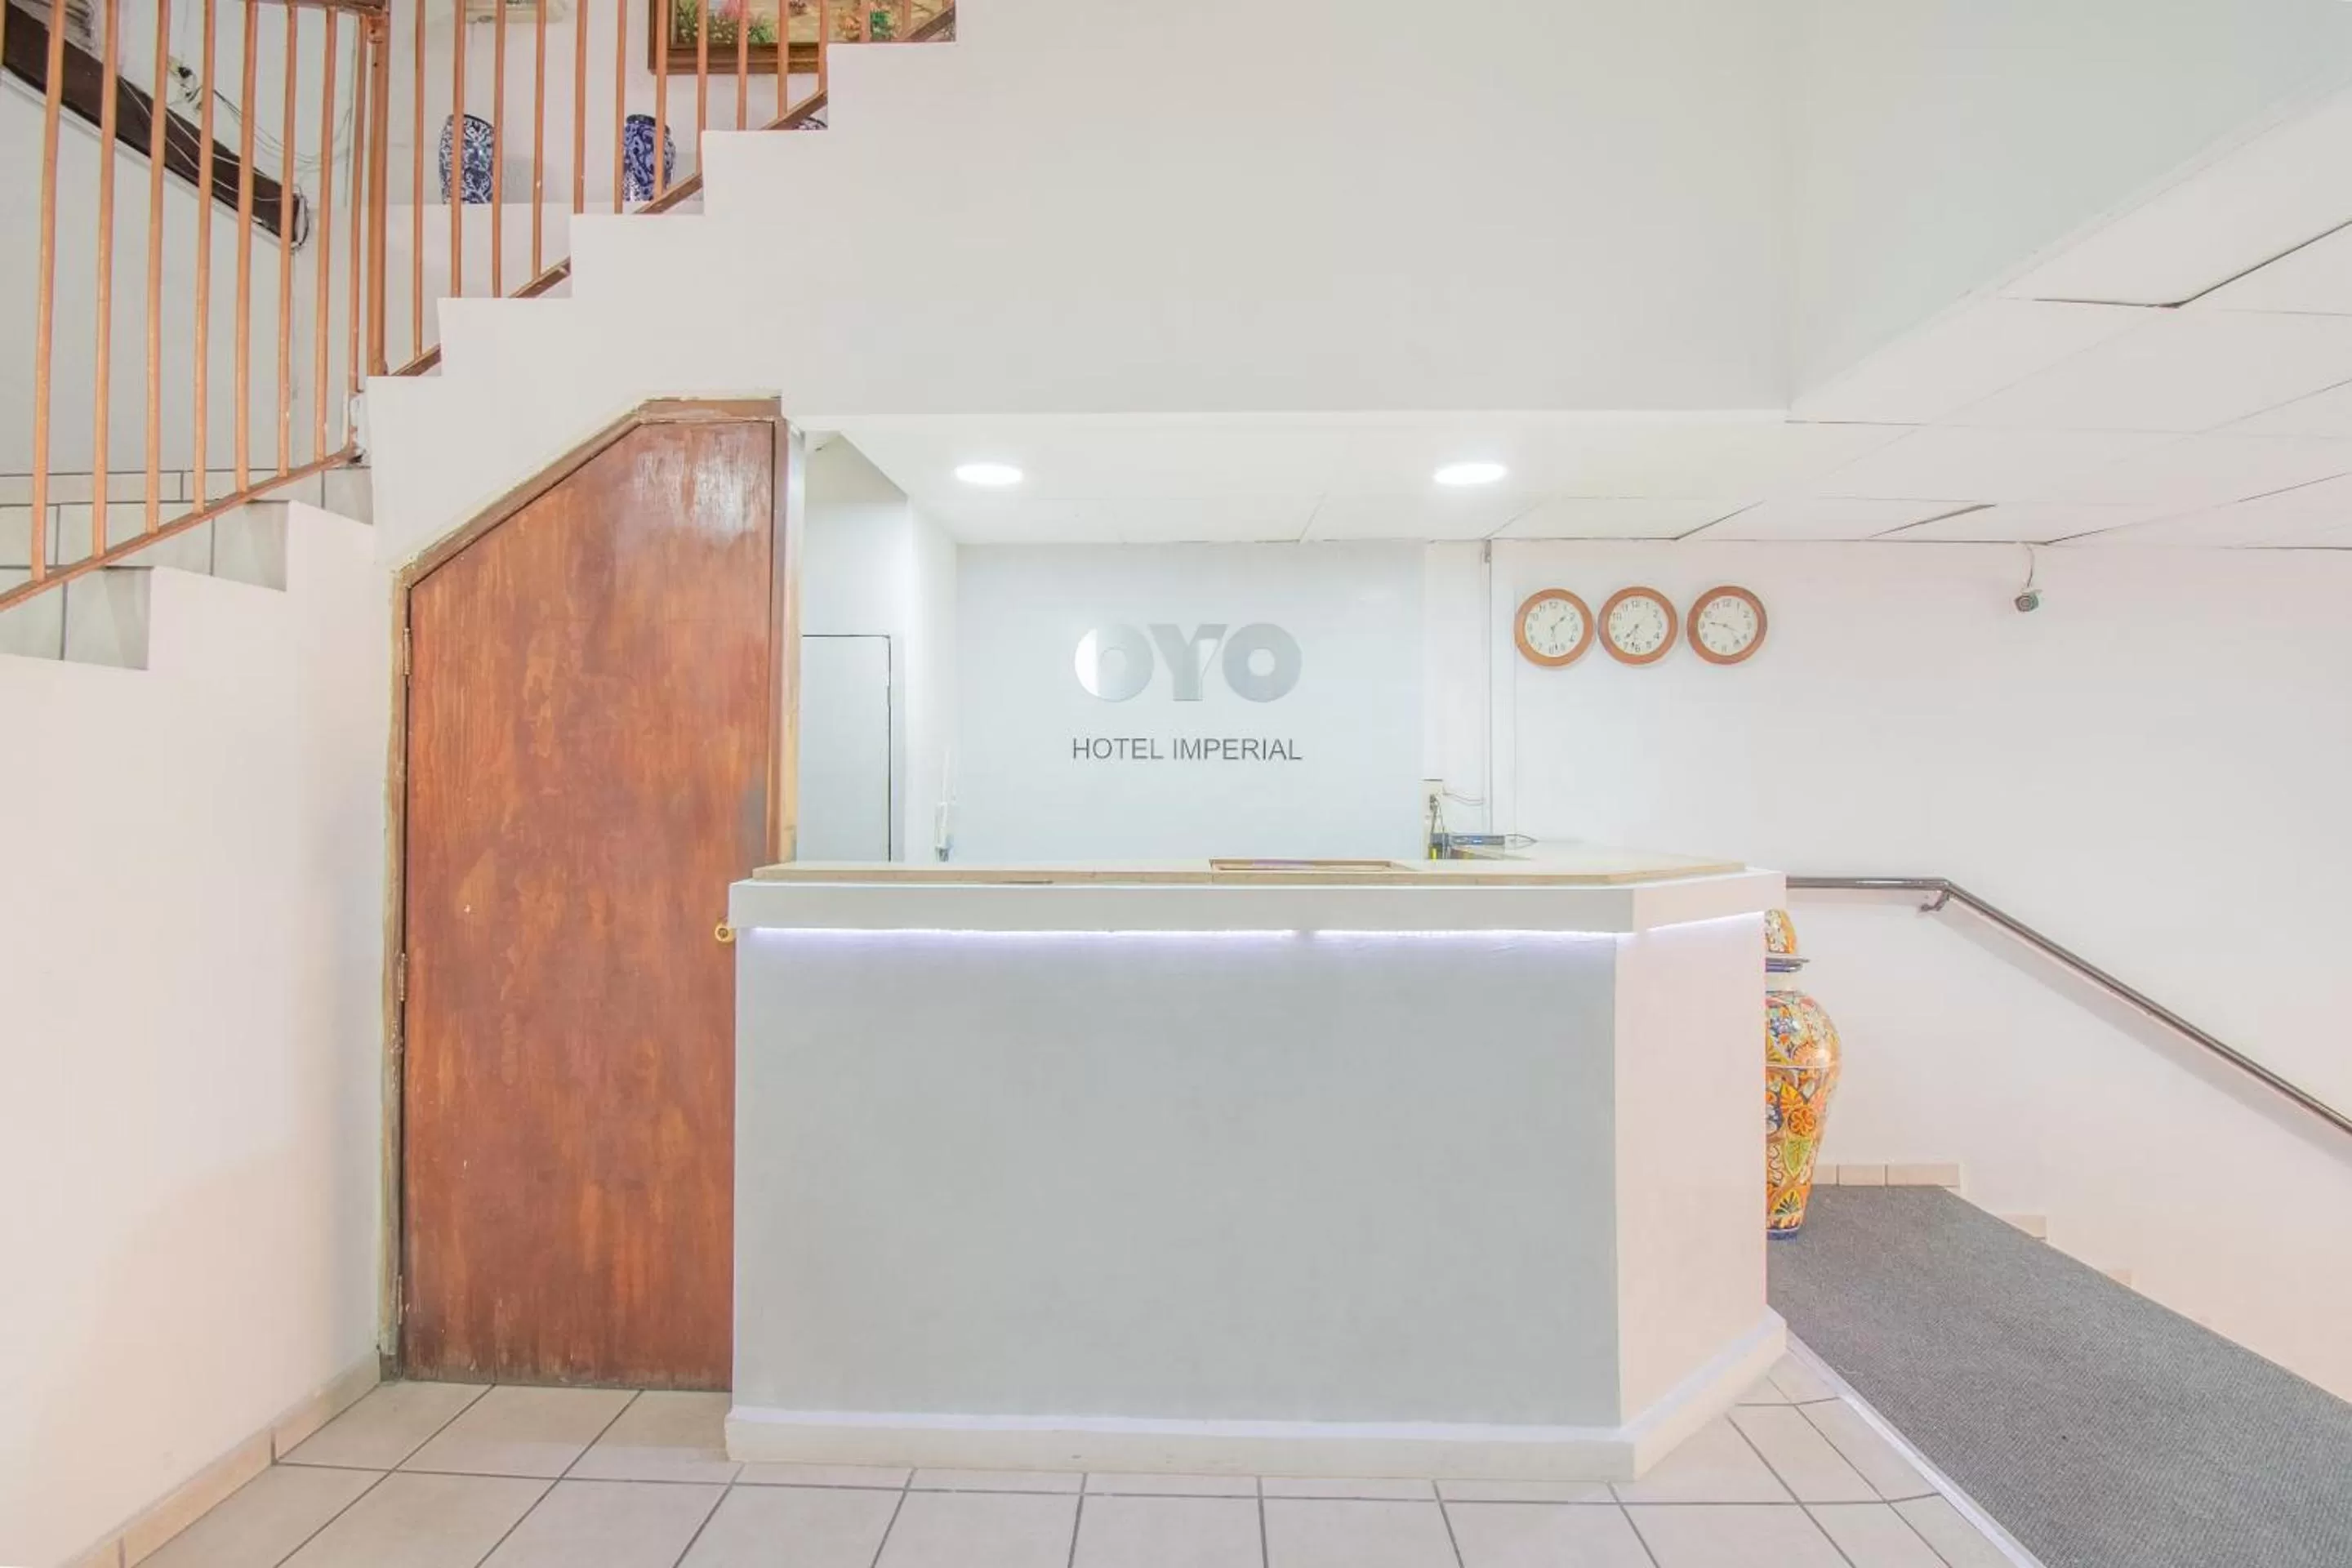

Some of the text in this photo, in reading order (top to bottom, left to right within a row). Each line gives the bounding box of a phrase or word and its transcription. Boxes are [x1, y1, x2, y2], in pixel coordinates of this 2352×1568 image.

[1074, 623, 1302, 702] OYO
[1072, 737, 1303, 760] HOTEL IMPERIAL
